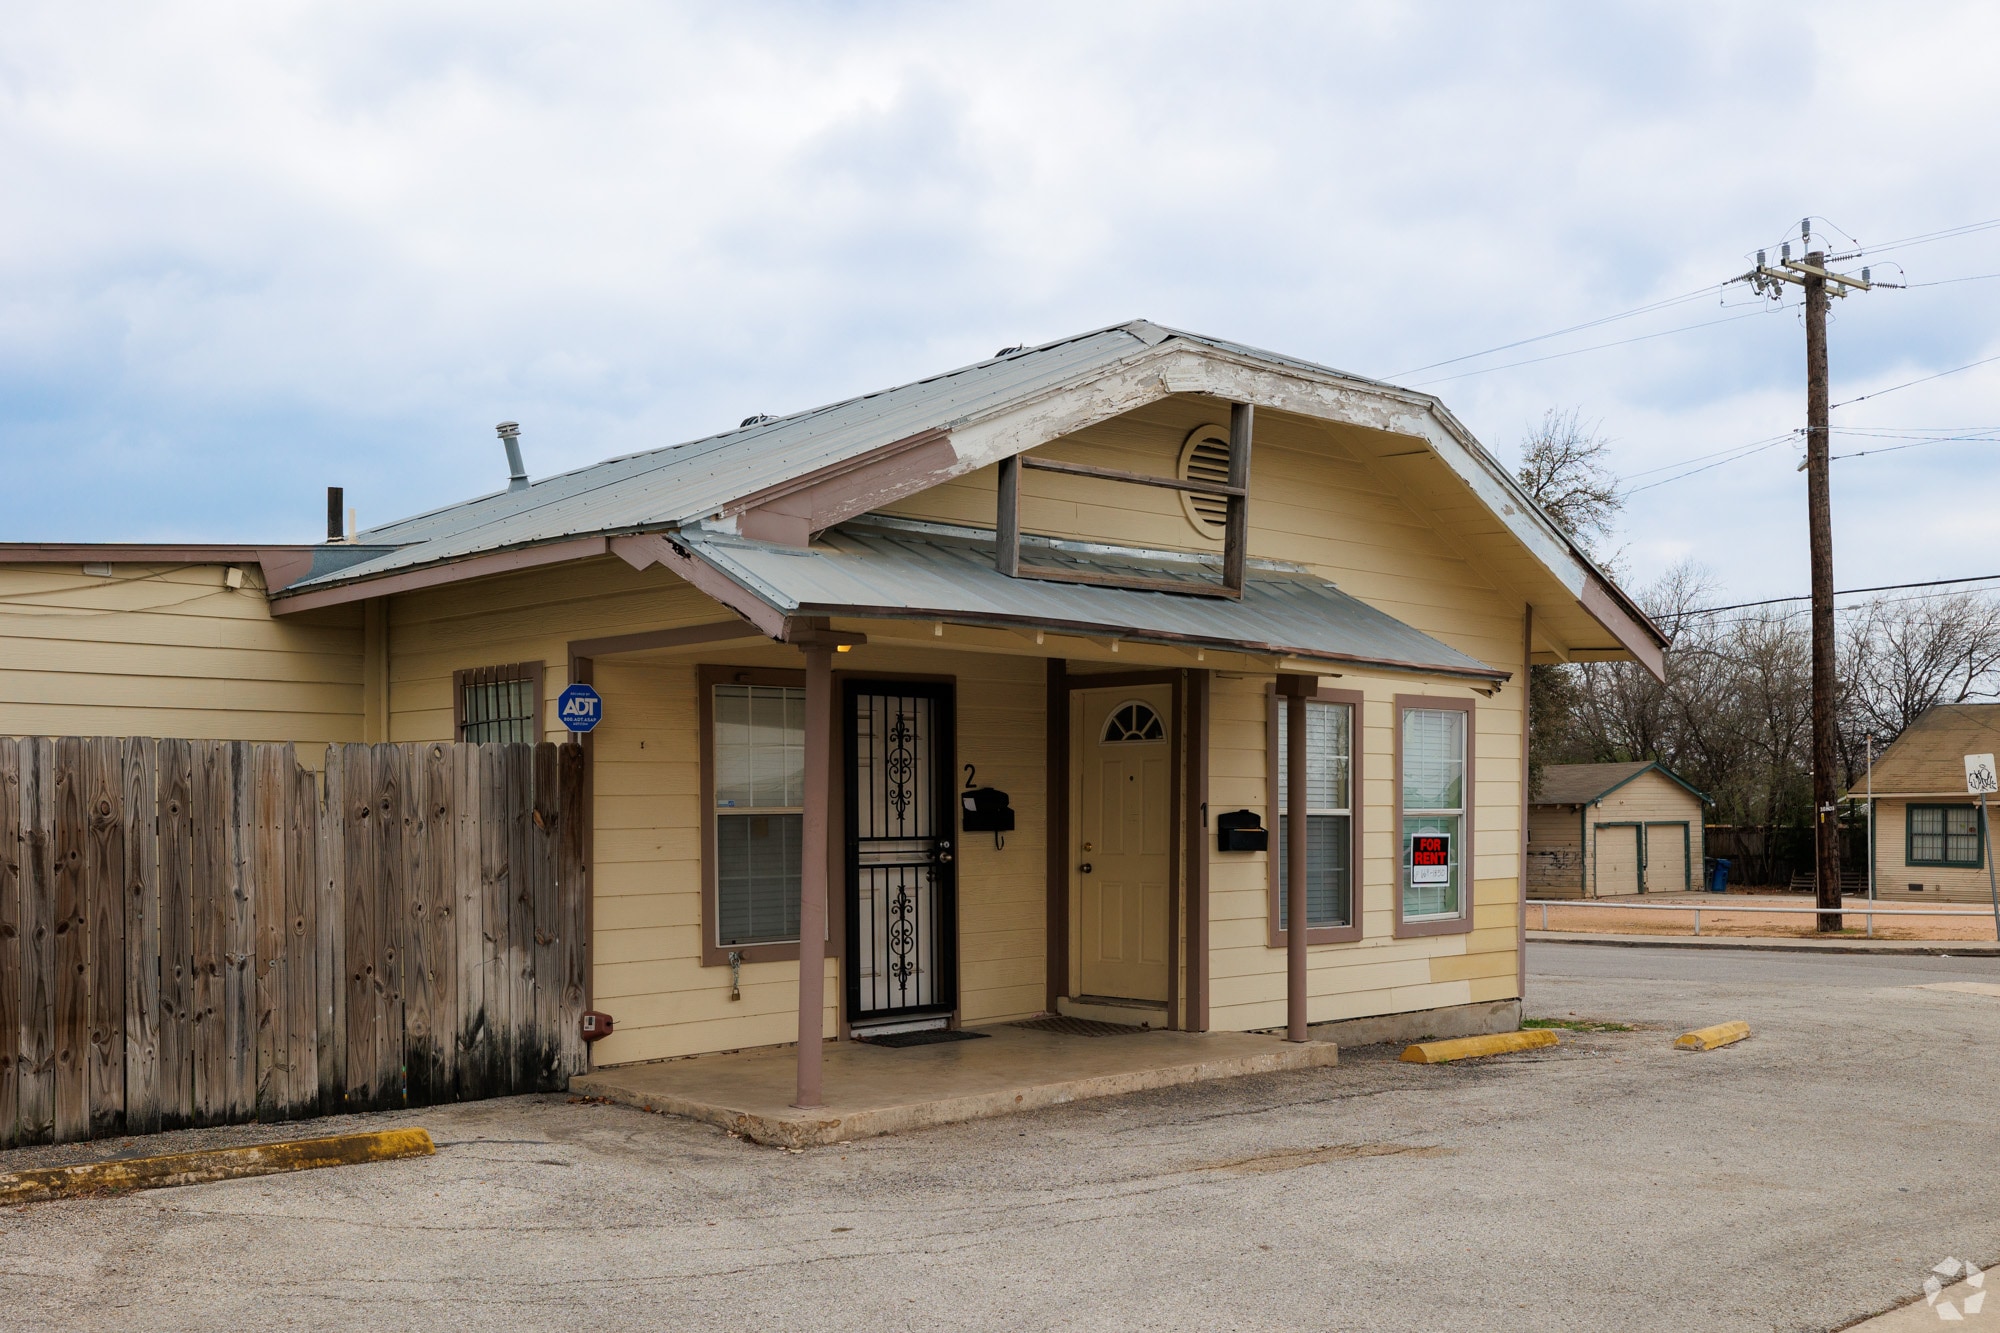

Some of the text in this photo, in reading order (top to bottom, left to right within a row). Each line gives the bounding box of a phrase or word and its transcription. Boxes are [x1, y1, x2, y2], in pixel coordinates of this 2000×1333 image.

[562, 697, 598, 716] ADT
[964, 764, 977, 788] 2
[1201, 802, 1207, 828] 1
[1420, 838, 1441, 851] FOR
[1414, 851, 1446, 865] RENT
